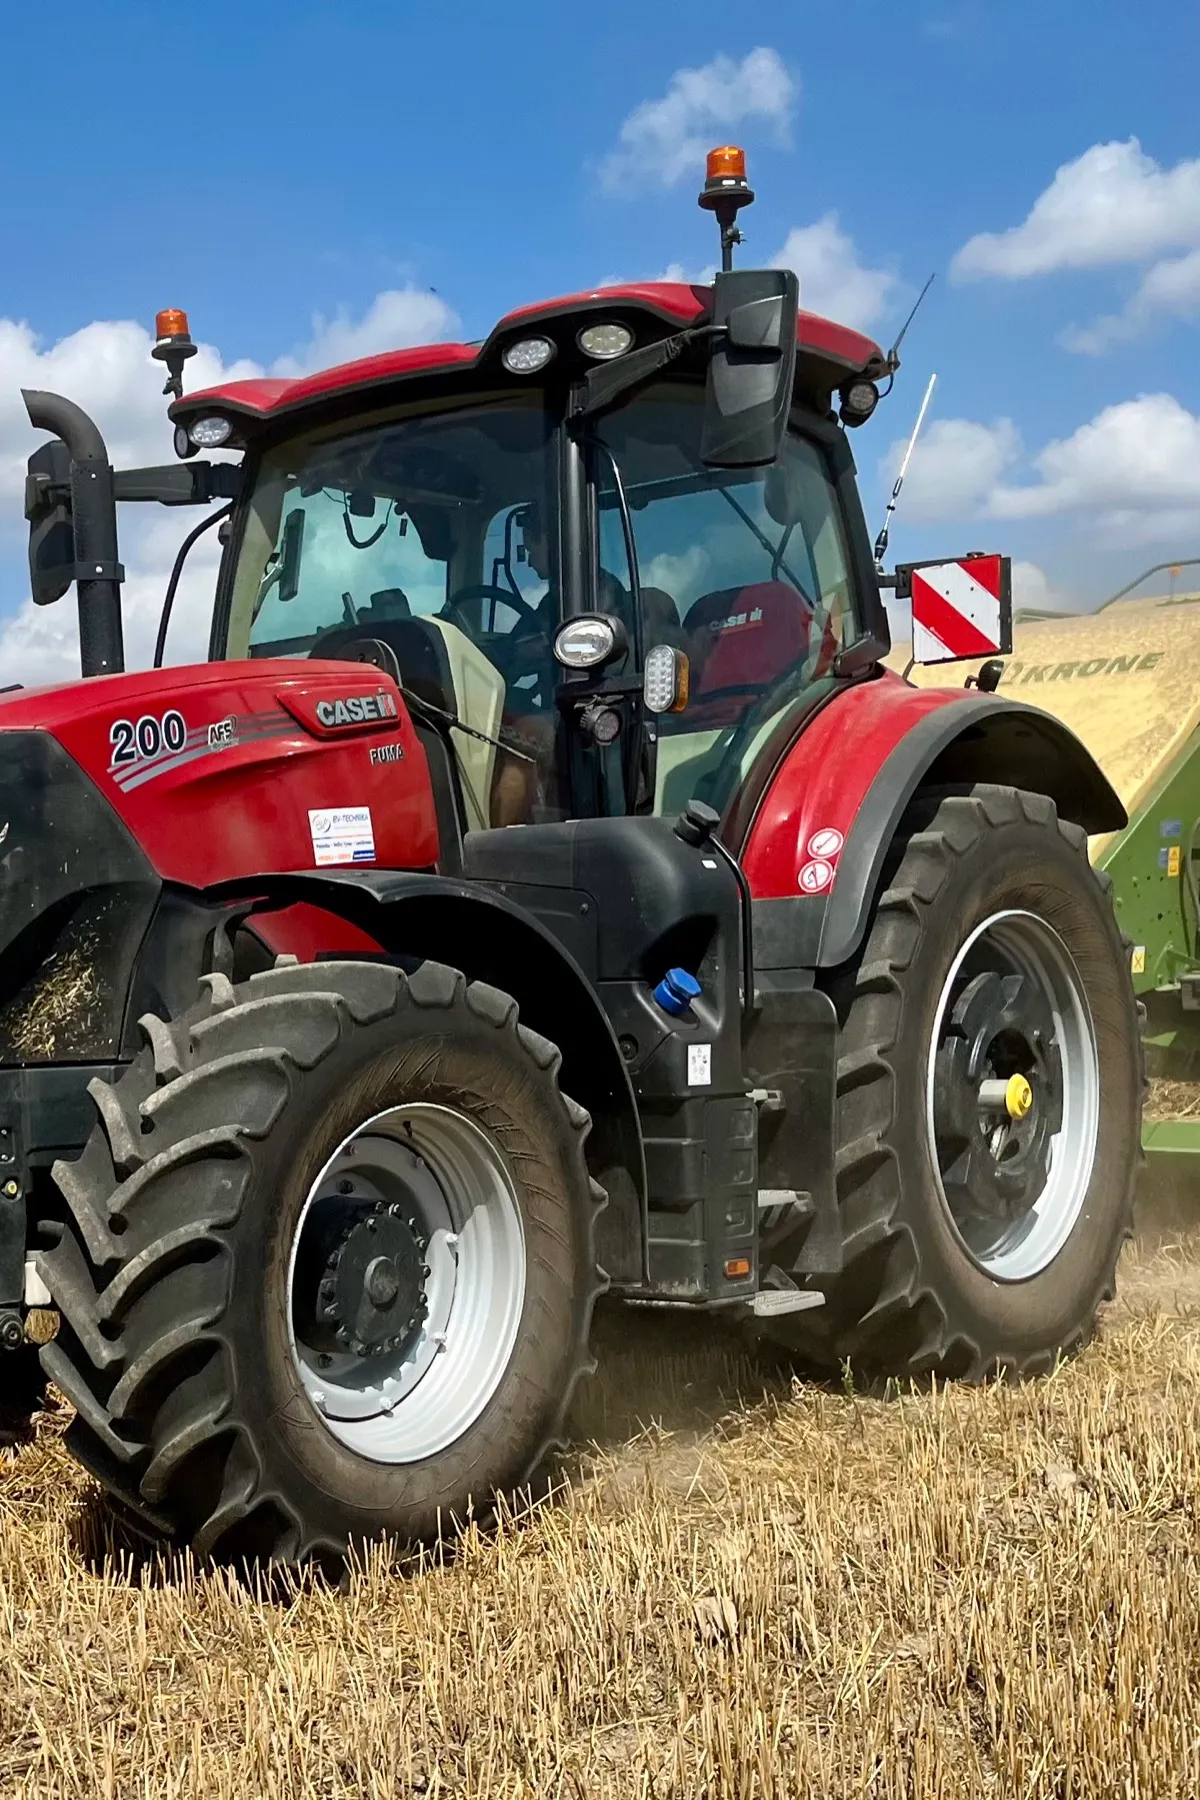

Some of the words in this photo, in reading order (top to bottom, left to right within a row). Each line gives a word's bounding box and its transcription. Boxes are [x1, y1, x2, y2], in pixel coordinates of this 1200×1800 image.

[708, 613, 747, 631] CASE
[1020, 652, 1166, 684] KRONE
[316, 697, 378, 726] CASE
[110, 709, 188, 767] 200
[208, 719, 233, 745] AFS
[369, 743, 404, 766] PUMA
